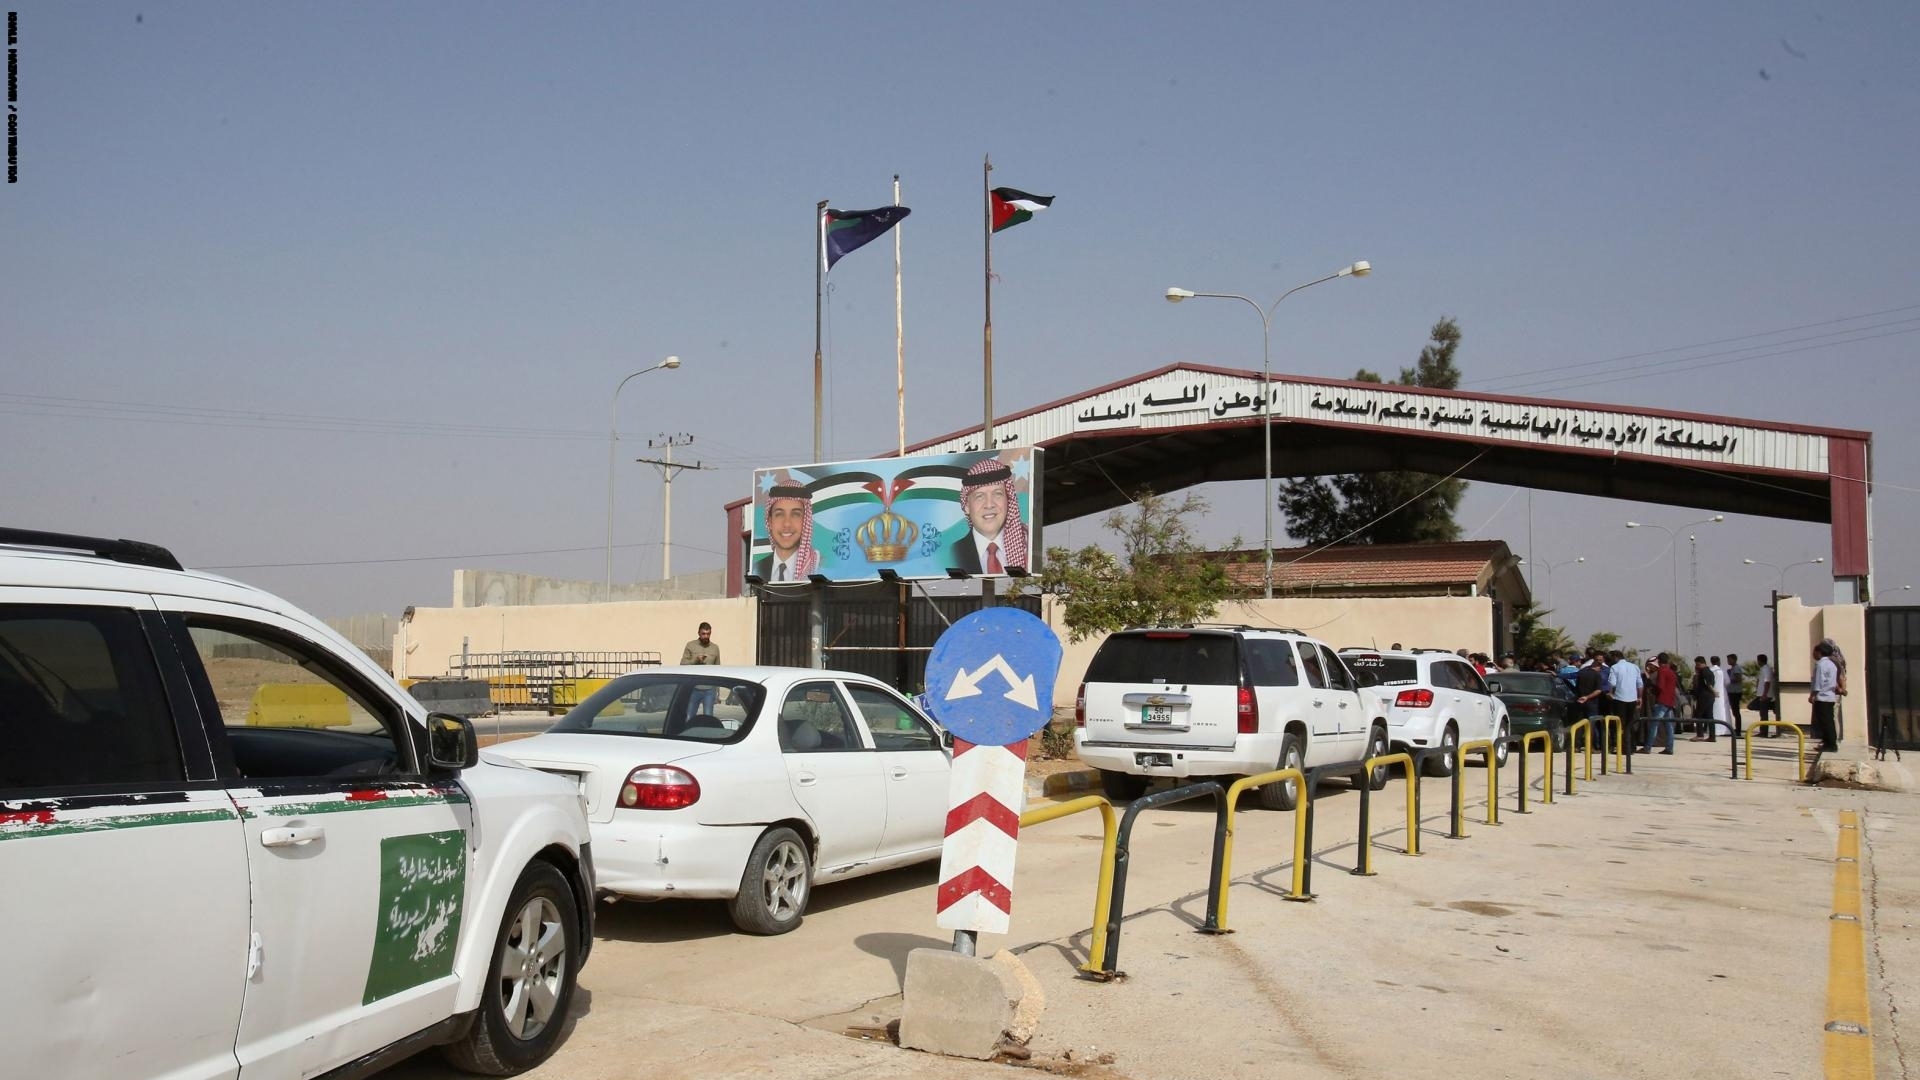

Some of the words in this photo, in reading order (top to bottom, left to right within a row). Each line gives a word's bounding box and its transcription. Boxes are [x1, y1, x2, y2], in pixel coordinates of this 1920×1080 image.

[1142, 383, 1206, 407] الله
[1310, 392, 1377, 417] السلامة
[1077, 402, 1136, 423] الملك
[1480, 409, 1567, 439] الهاشمية
[1569, 415, 1648, 446] الأردنية
[1654, 426, 1738, 455] المملكة
